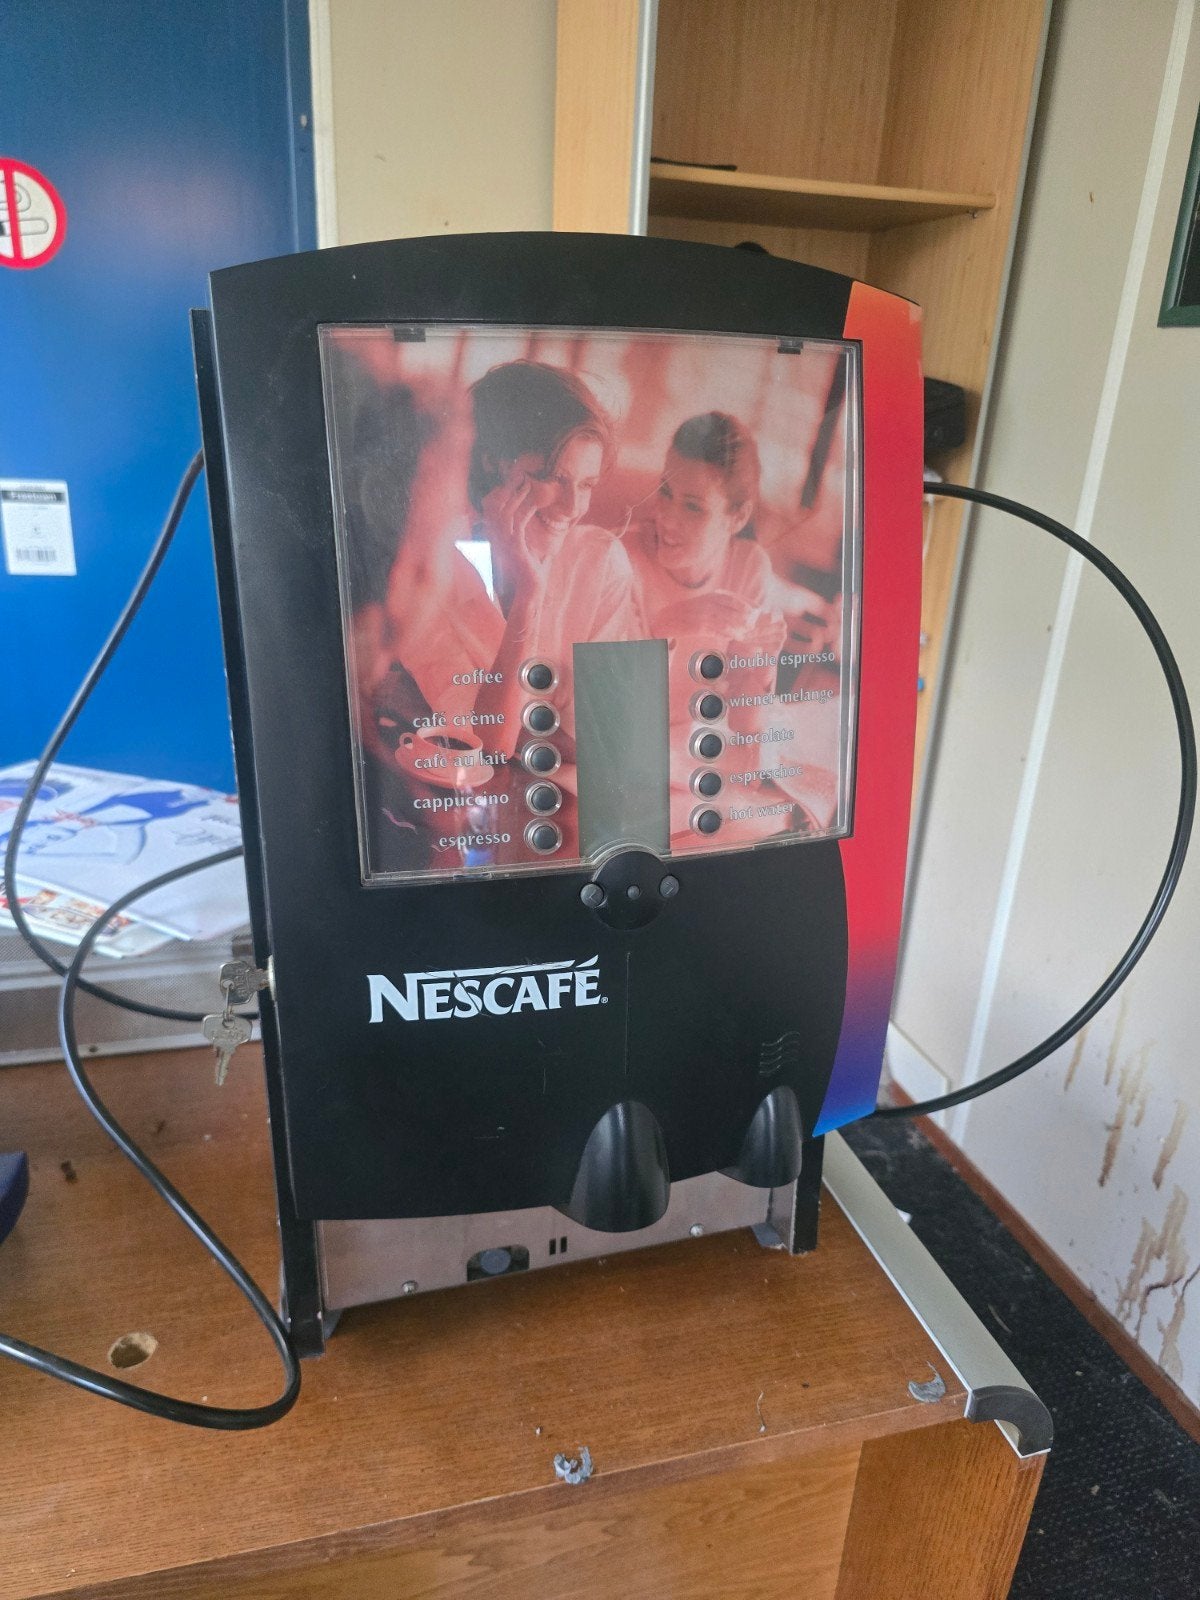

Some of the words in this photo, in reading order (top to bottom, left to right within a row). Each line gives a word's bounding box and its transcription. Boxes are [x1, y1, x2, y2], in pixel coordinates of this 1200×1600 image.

[730, 654, 775, 670] double
[780, 651, 835, 668] espresso
[453, 670, 503, 685] coffee
[730, 692, 776, 708] wiener
[780, 687, 834, 707] melange
[413, 712, 447, 728] café
[452, 710, 505, 726] crème
[730, 728, 795, 746] chocolate
[453, 754, 474, 767] au
[479, 751, 507, 766] lait
[413, 792, 509, 811] cappuccino
[730, 805, 754, 820] hot
[758, 802, 795, 819] water
[439, 832, 510, 848] espresso
